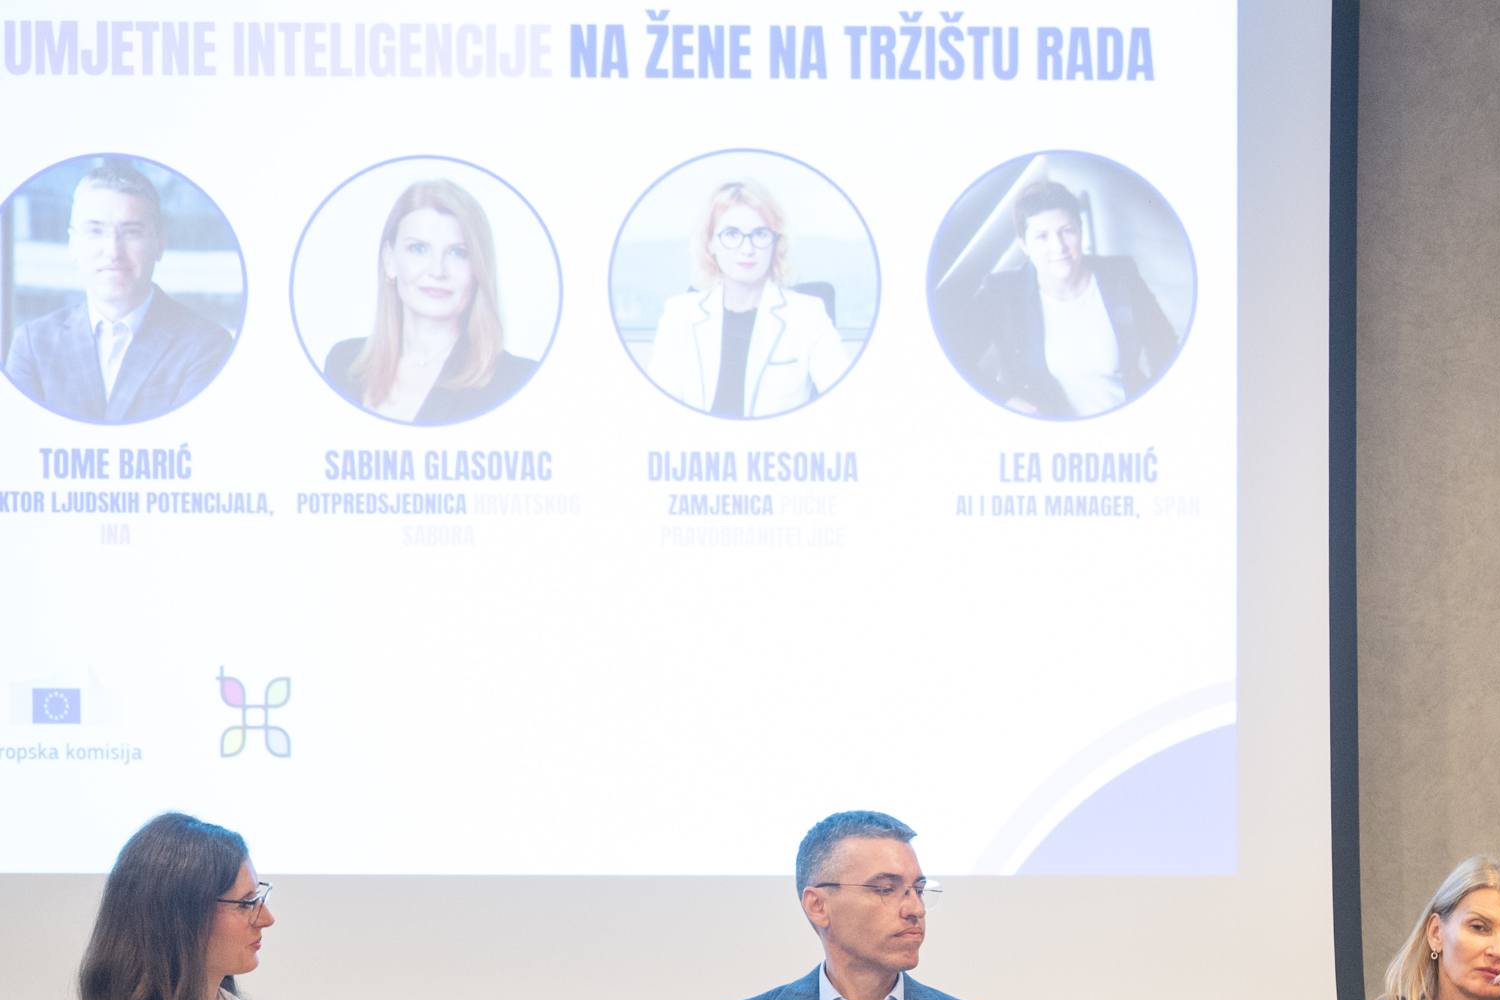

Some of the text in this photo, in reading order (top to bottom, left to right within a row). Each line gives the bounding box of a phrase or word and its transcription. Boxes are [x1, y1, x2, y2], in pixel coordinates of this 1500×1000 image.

[4, 9, 1154, 81] UMJETNE INTELIGENCIJE NA ŽENE NA TRŽIŠTU RADA
[39, 443, 191, 479] TOME BARIĆ
[325, 450, 552, 481] SABINA GLASOVAC
[648, 451, 858, 482] DIJANA KESONJA
[1000, 446, 1157, 483] LEA ORDANIĆ
[51, 491, 139, 513] LJUDSKIH
[146, 492, 273, 516] POTENCIJALA,
[297, 493, 466, 514] POTPREDSJEDNICA
[669, 494, 773, 515] ZAMJENICA
[956, 495, 973, 516] AI
[980, 495, 985, 516] I
[992, 495, 1037, 516] DATA
[1045, 495, 1139, 518] MANAGER,
[101, 523, 130, 544] INA
[66, 742, 143, 765] komisija
